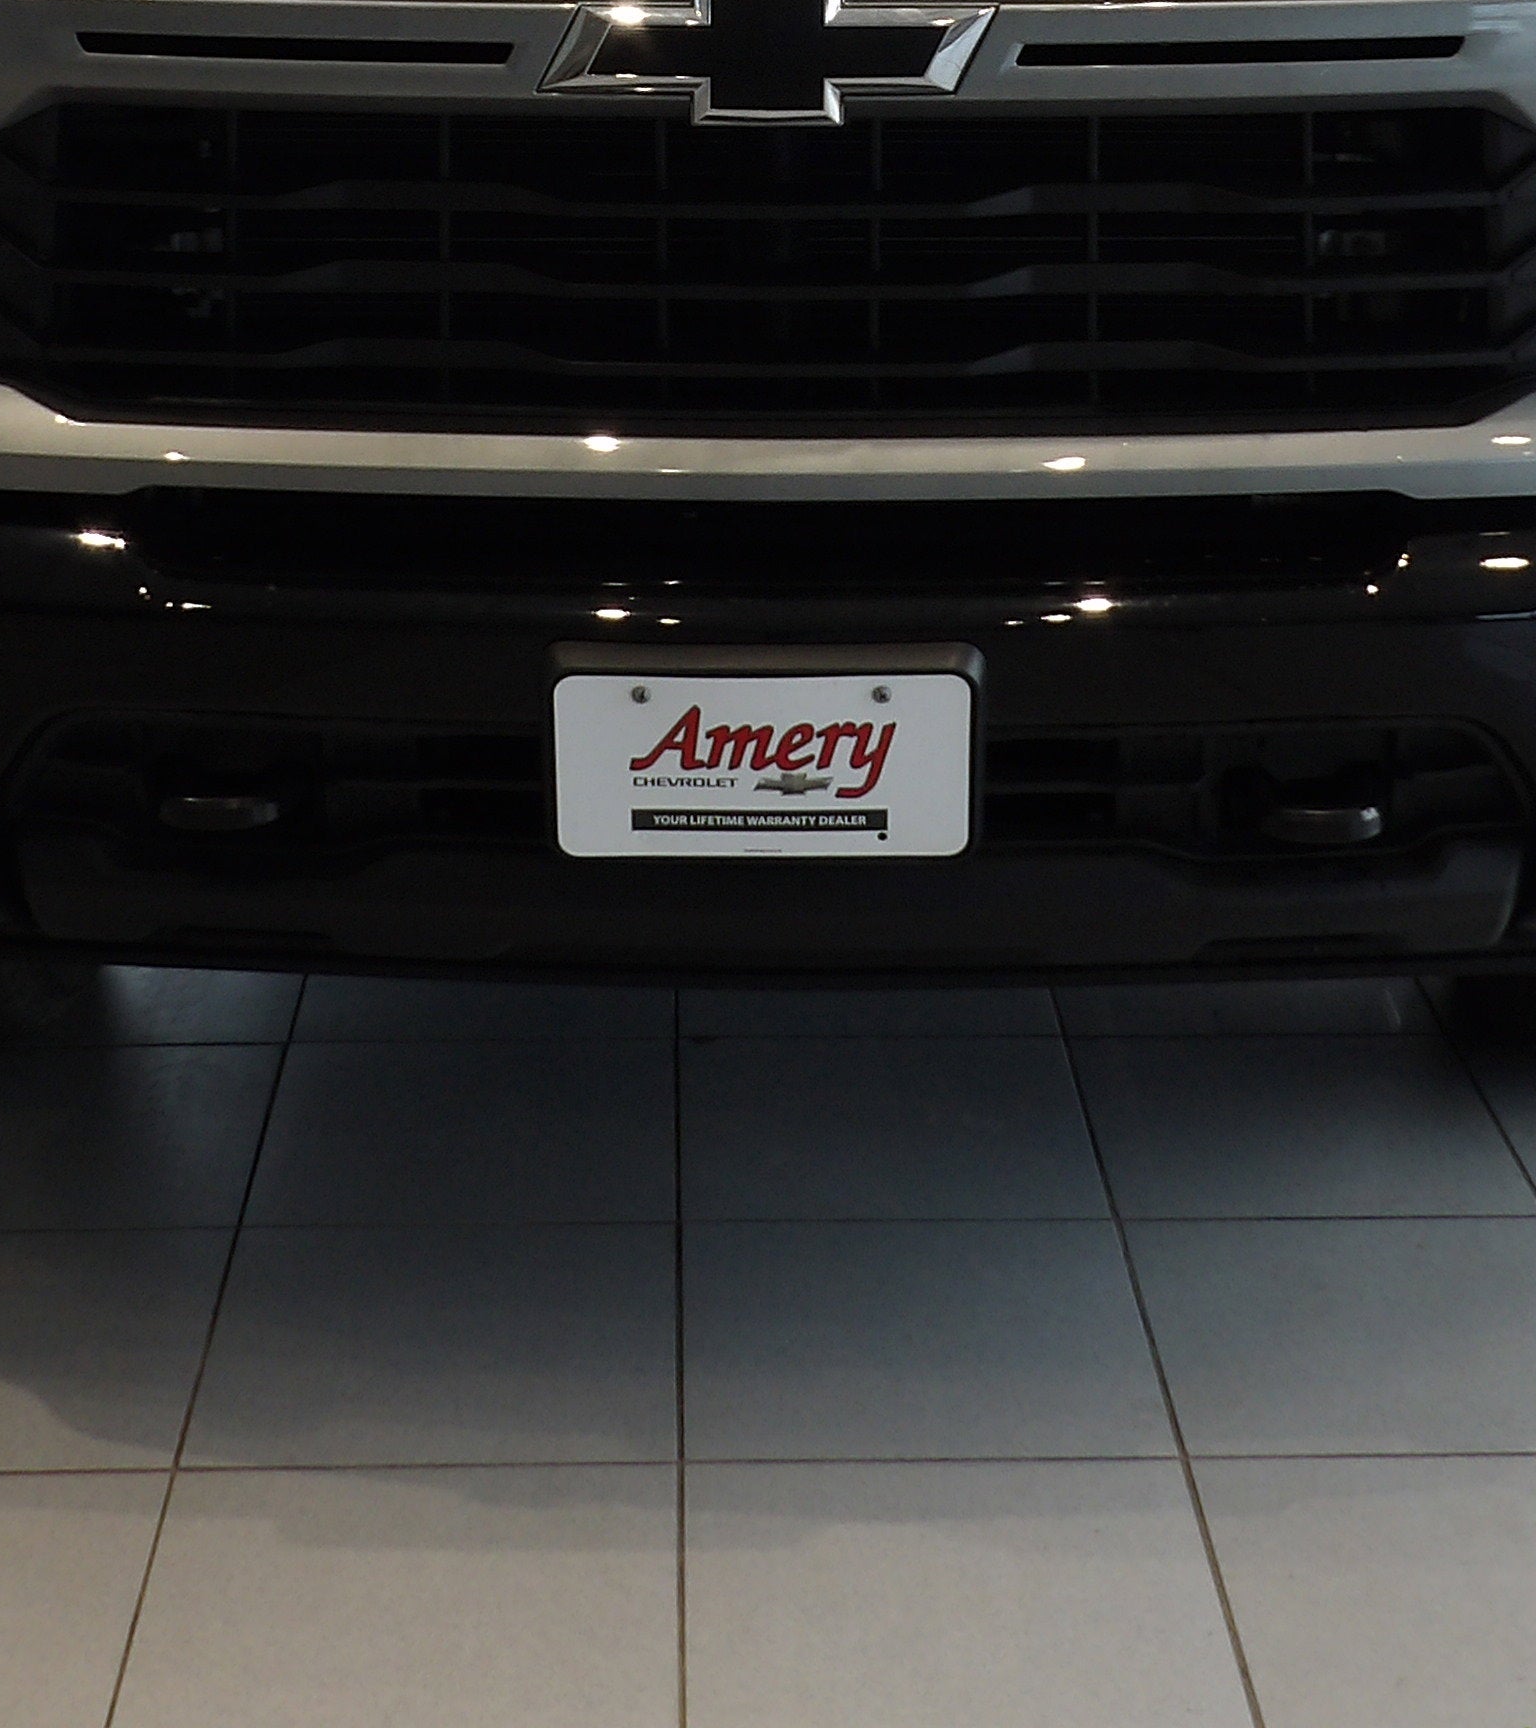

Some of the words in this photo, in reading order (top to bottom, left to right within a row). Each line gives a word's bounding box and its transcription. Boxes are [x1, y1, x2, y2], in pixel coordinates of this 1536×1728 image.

[628, 704, 897, 799] Amery
[632, 775, 739, 788] CHEVROLET
[652, 814, 687, 827] YOUR
[689, 814, 745, 827] LIFETIME
[746, 814, 817, 827] WARRANTY
[818, 815, 868, 827] DEALER
